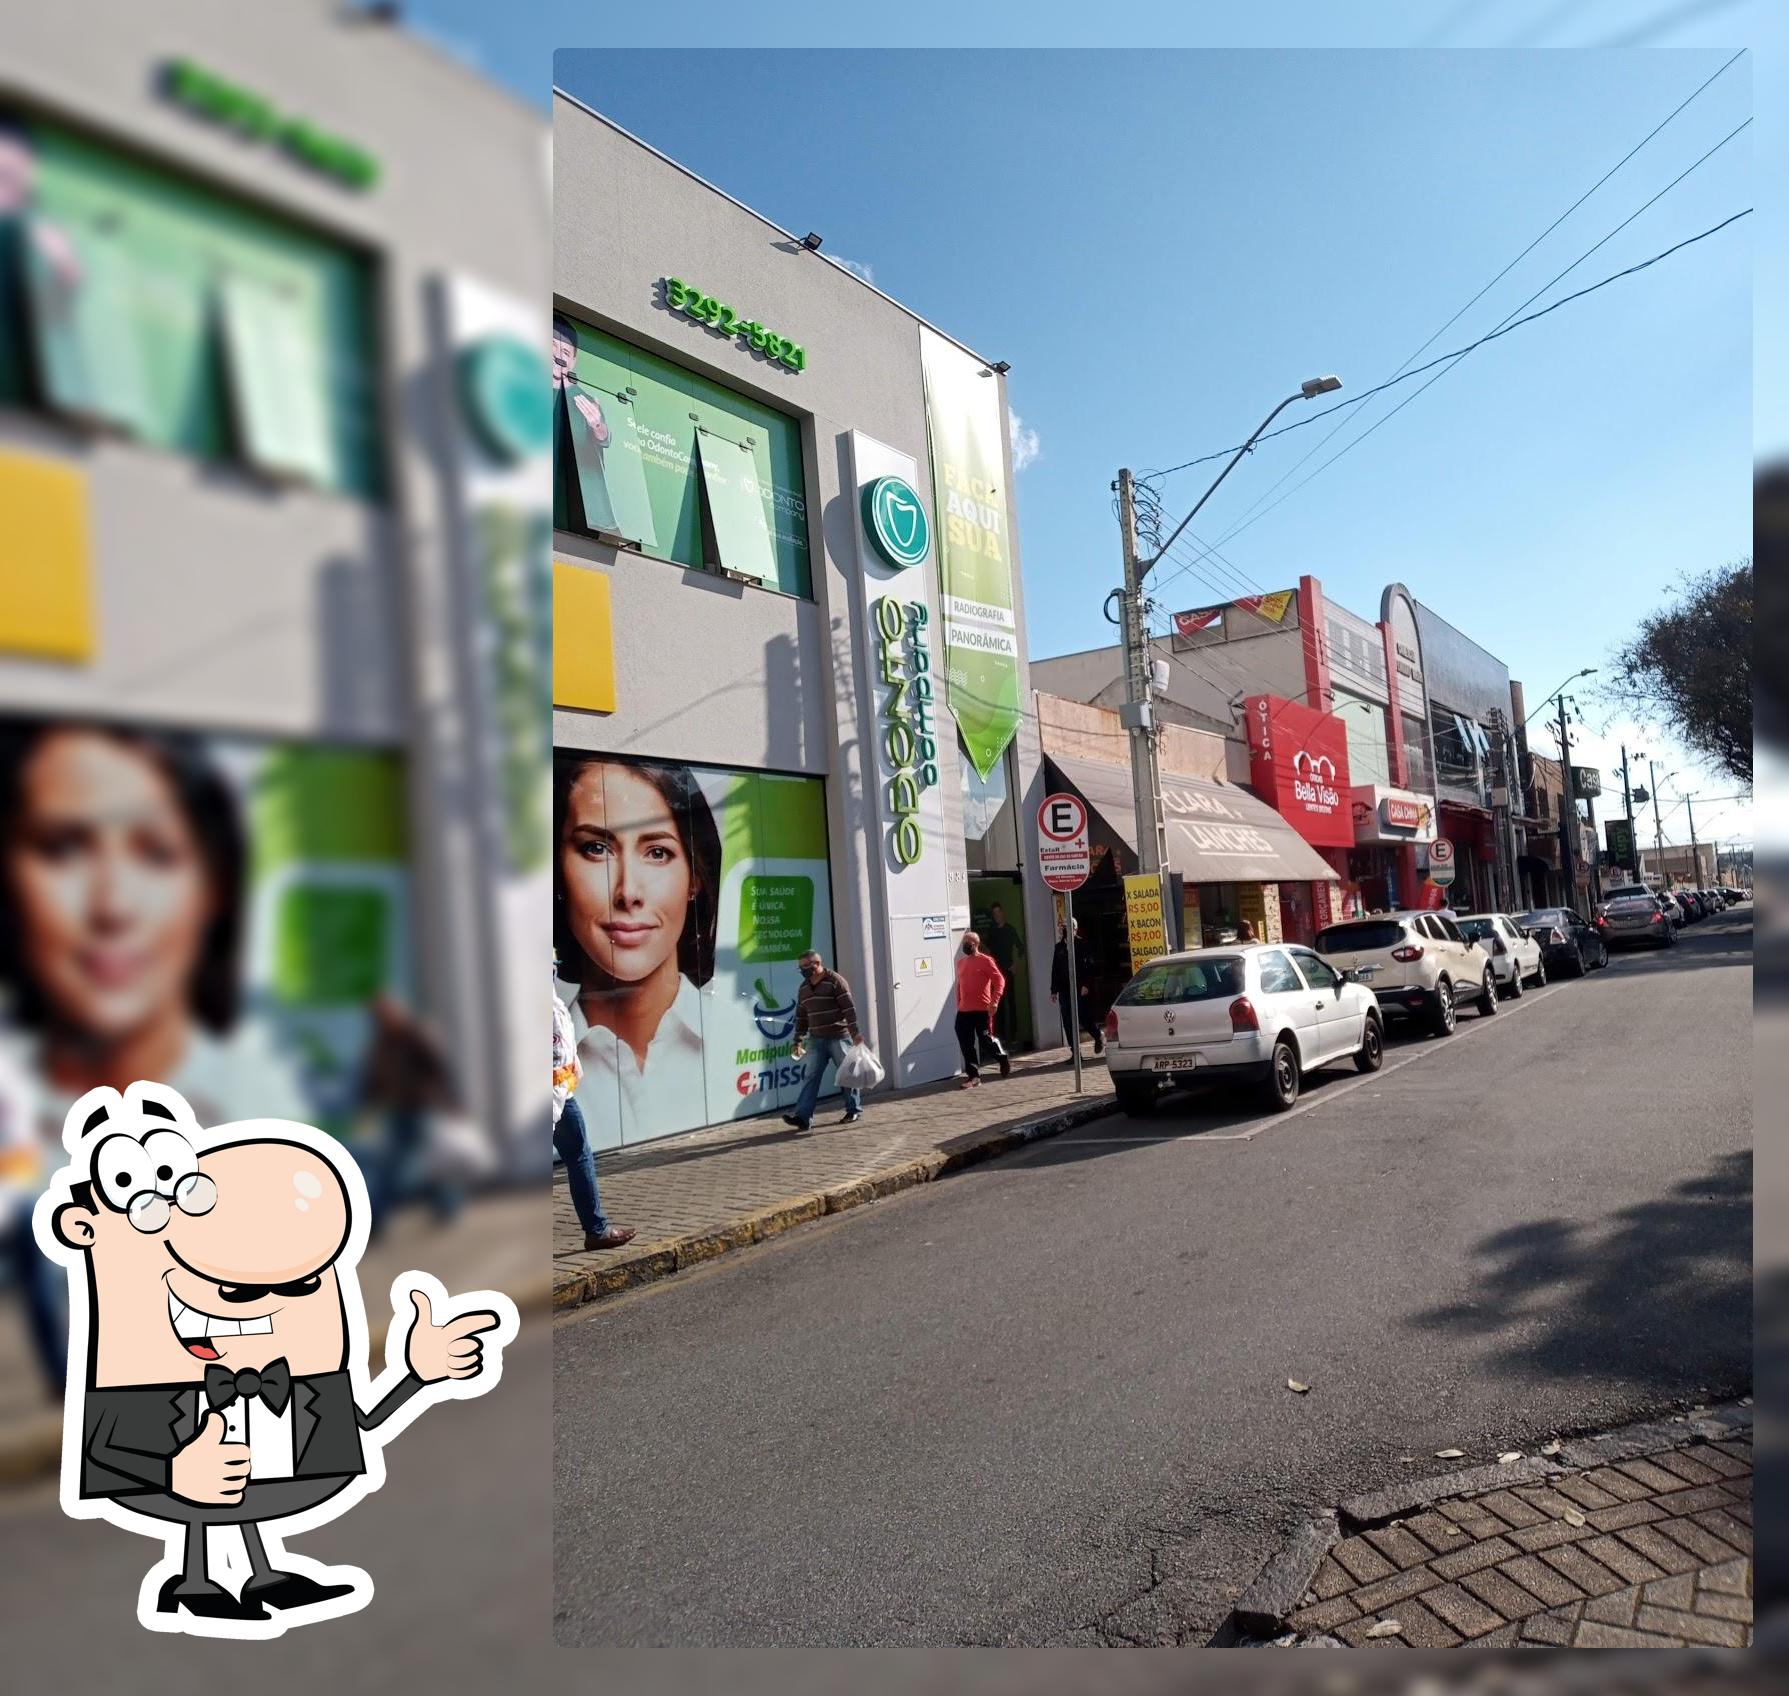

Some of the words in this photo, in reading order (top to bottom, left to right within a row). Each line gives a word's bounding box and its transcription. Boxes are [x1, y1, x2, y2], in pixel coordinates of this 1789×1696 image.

[665, 276, 806, 373] 3292-5821
[636, 424, 650, 436] ele
[650, 430, 676, 446] confia
[642, 452, 675, 469] ambém
[647, 439, 720, 473] OdontoCoany,
[947, 490, 1001, 536] AQUI
[948, 513, 1002, 563] SUA
[953, 601, 1005, 623] RADIOGRAFIA
[951, 629, 1012, 653] PANORÂMICA
[1294, 780, 1316, 803] Bella
[1316, 783, 1339, 807] Visão
[1052, 803, 1073, 833] E
[1179, 823, 1274, 852] LANCHES
[1436, 843, 1446, 858] E
[1044, 864, 1085, 872] Farmácia
[1127, 892, 1132, 900] X
[1134, 888, 1160, 899] SALADA
[1141, 902, 1160, 914] 5,00
[1131, 920, 1136, 929] X
[1137, 919, 1161, 929] BACON
[1144, 930, 1161, 941] 7,00
[1132, 946, 1164, 957] SALGADO
